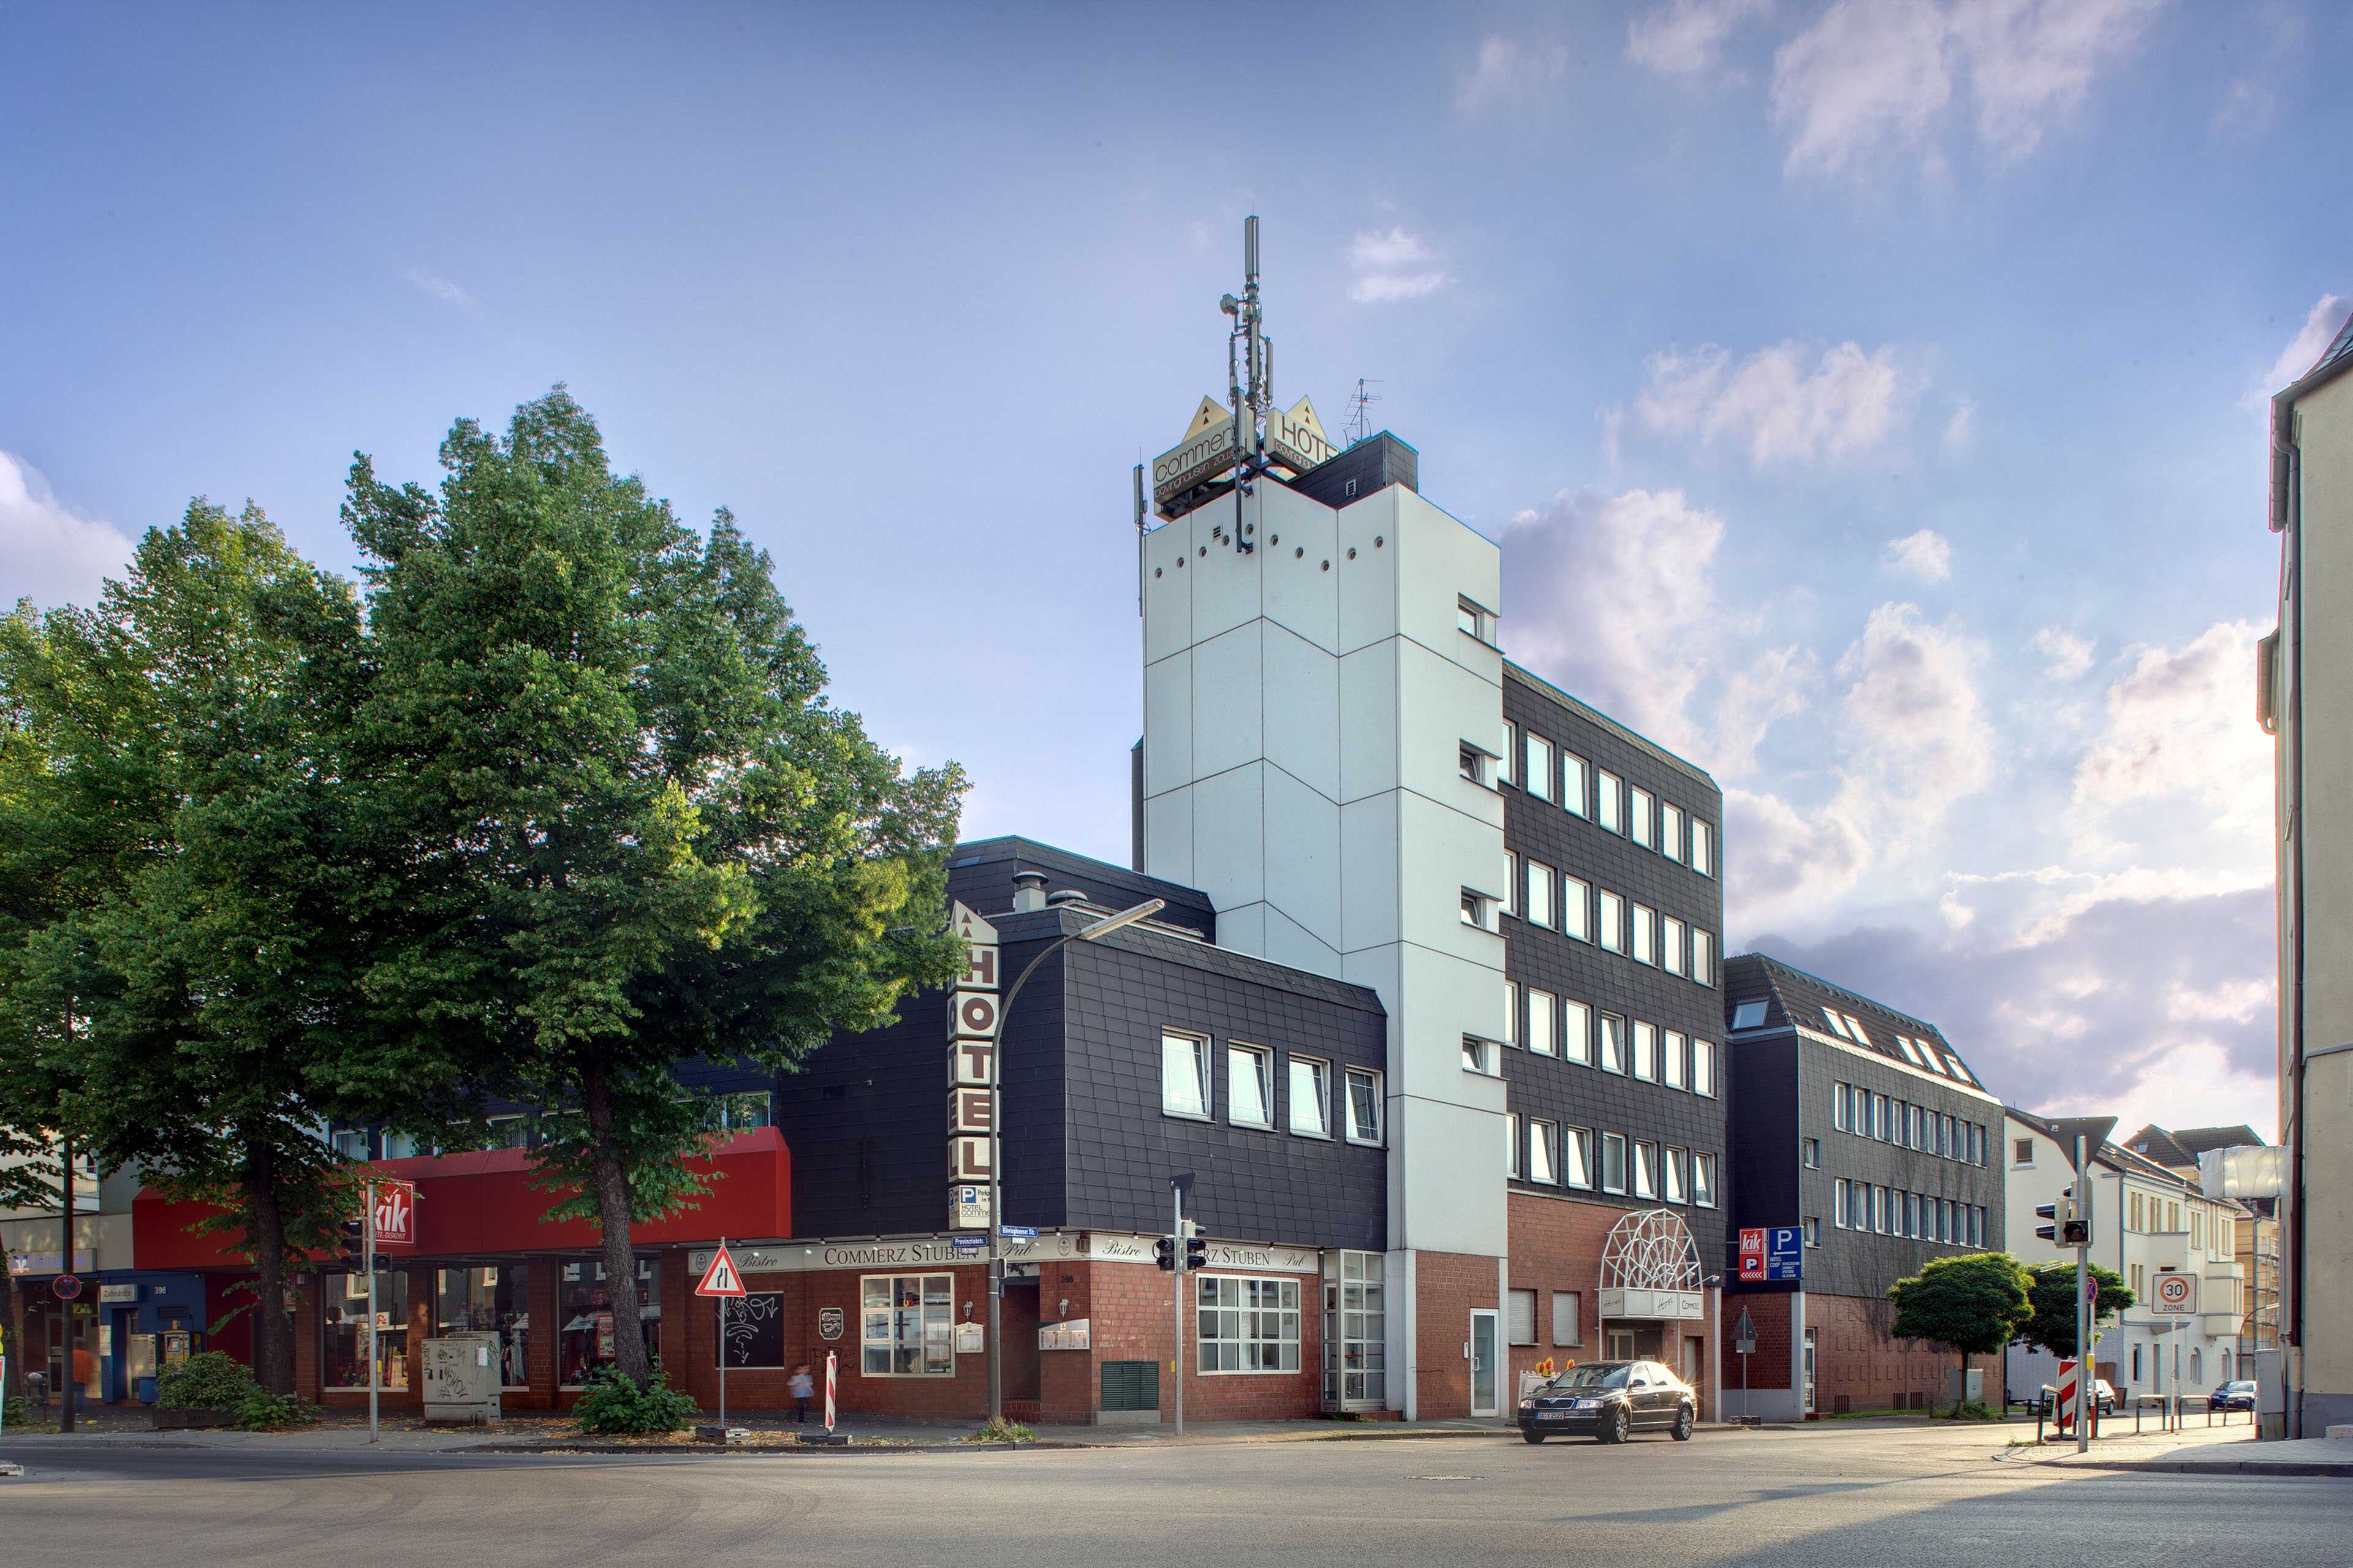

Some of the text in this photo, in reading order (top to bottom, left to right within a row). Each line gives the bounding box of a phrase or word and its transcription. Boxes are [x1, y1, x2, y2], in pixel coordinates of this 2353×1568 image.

[1281, 415, 1342, 462] HOTE
[1155, 427, 1236, 482] commer
[960, 950, 994, 1175] HOTEL
[999, 1242, 1037, 1257] Pub
[1102, 1239, 1141, 1257] Bistro
[1742, 1230, 1761, 1250] kik
[1778, 1230, 1792, 1250] P
[737, 1254, 778, 1268] Bistro
[825, 1248, 907, 1265] COMMERZ
[1222, 1247, 1270, 1265] STUBEN
[1283, 1253, 1306, 1267] Pub
[2166, 1284, 2182, 1296] 30
